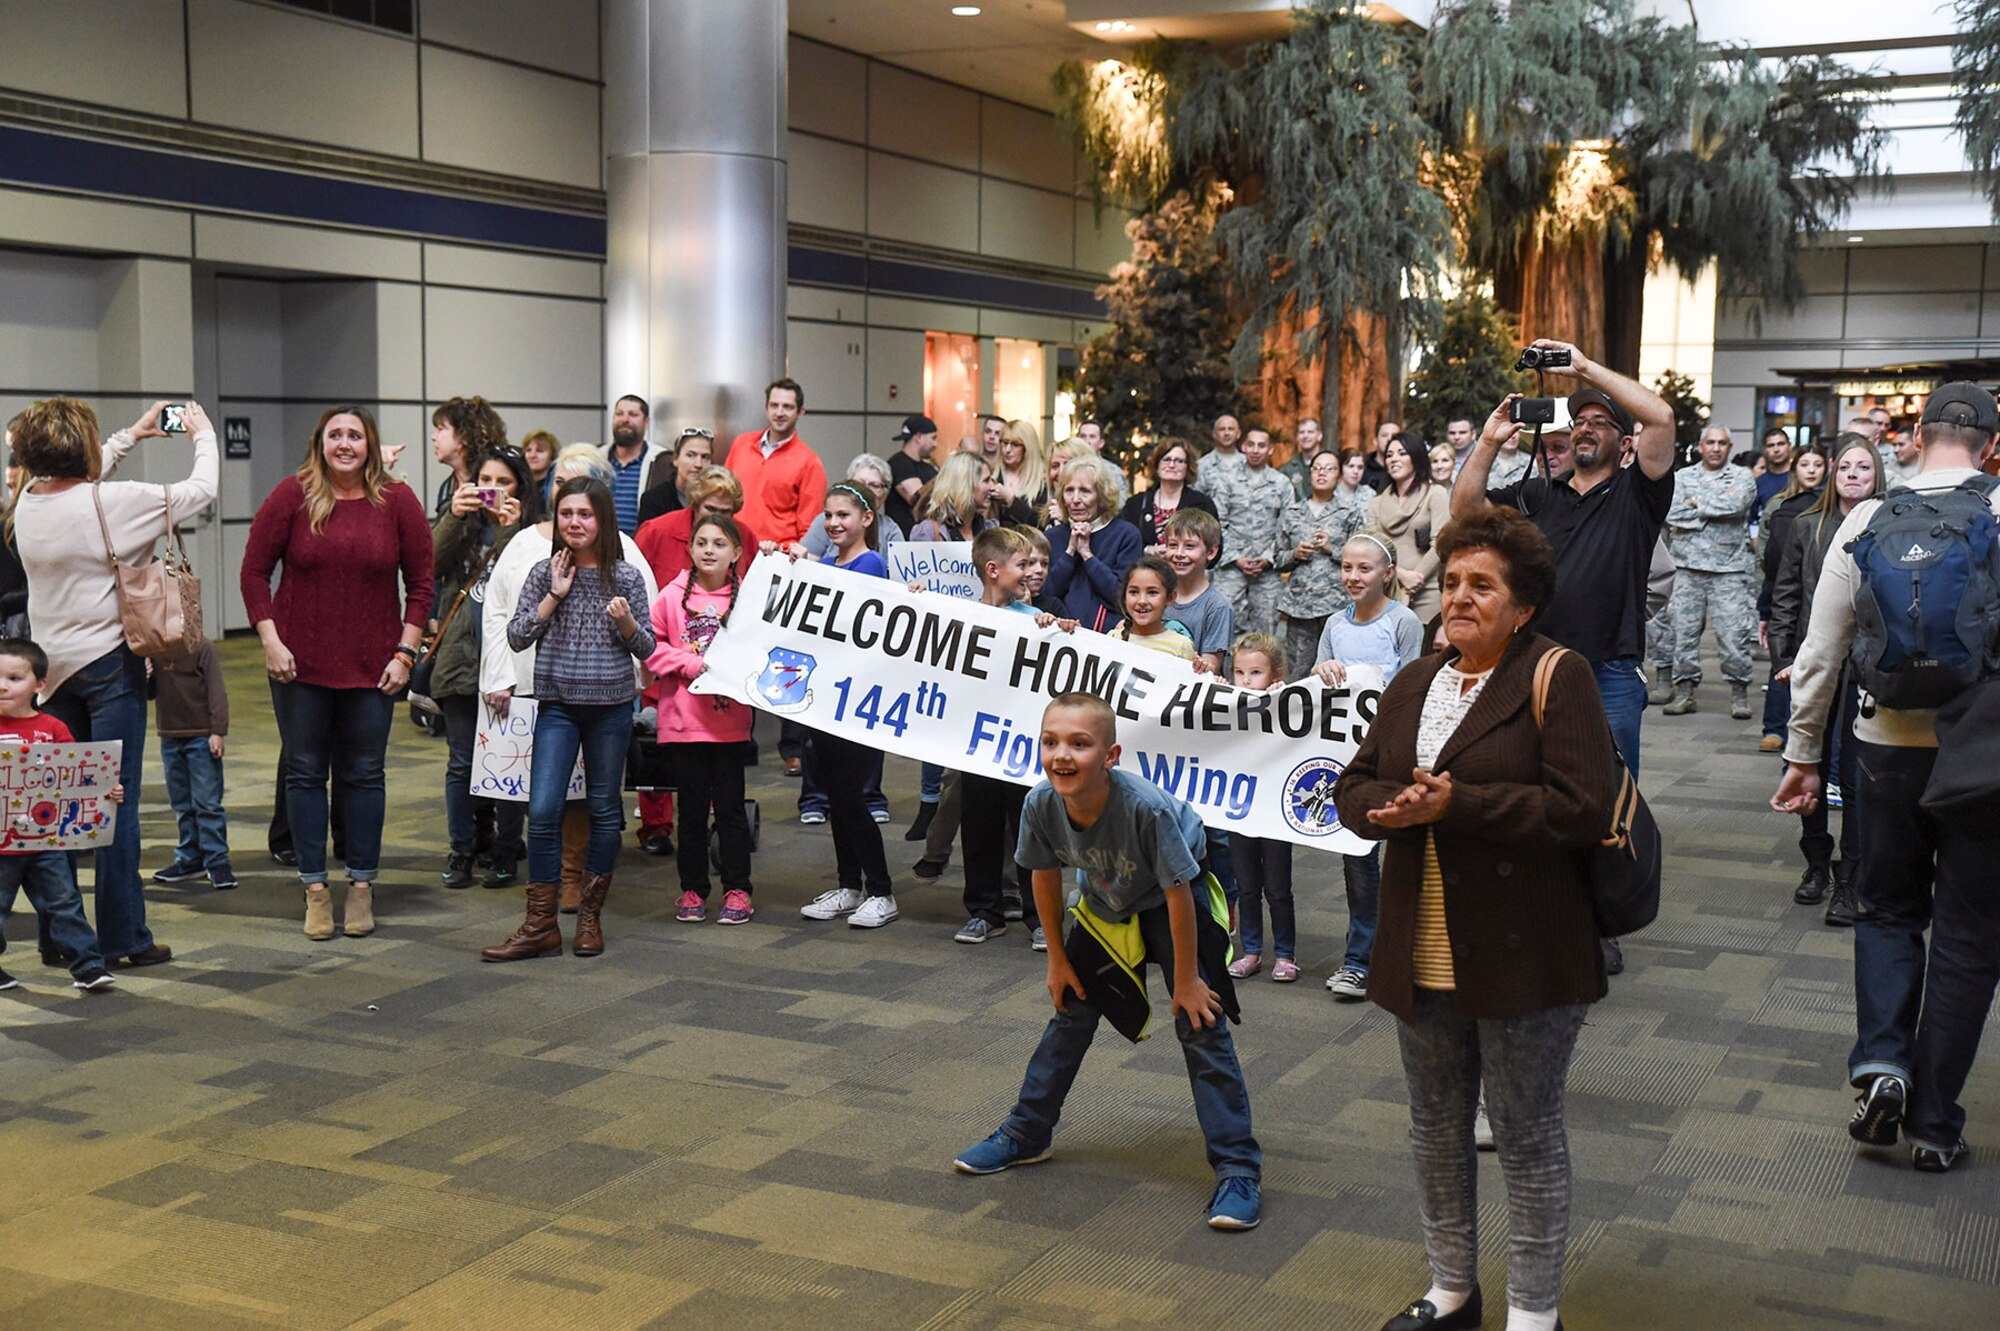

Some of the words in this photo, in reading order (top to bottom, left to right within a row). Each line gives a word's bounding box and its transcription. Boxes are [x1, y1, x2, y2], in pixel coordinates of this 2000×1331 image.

[894, 549, 975, 582] Welcom
[928, 579, 974, 597] Home
[762, 574, 997, 680] WELCOME
[1009, 636, 1157, 722] HOME
[1160, 682, 1381, 746] HEROES
[834, 677, 947, 738] 144th
[1137, 751, 1258, 820] Wing
[1295, 761, 1320, 778] KEEPING
[1323, 761, 1337, 770] OUR
[1294, 820, 1324, 833] NATIONAL
